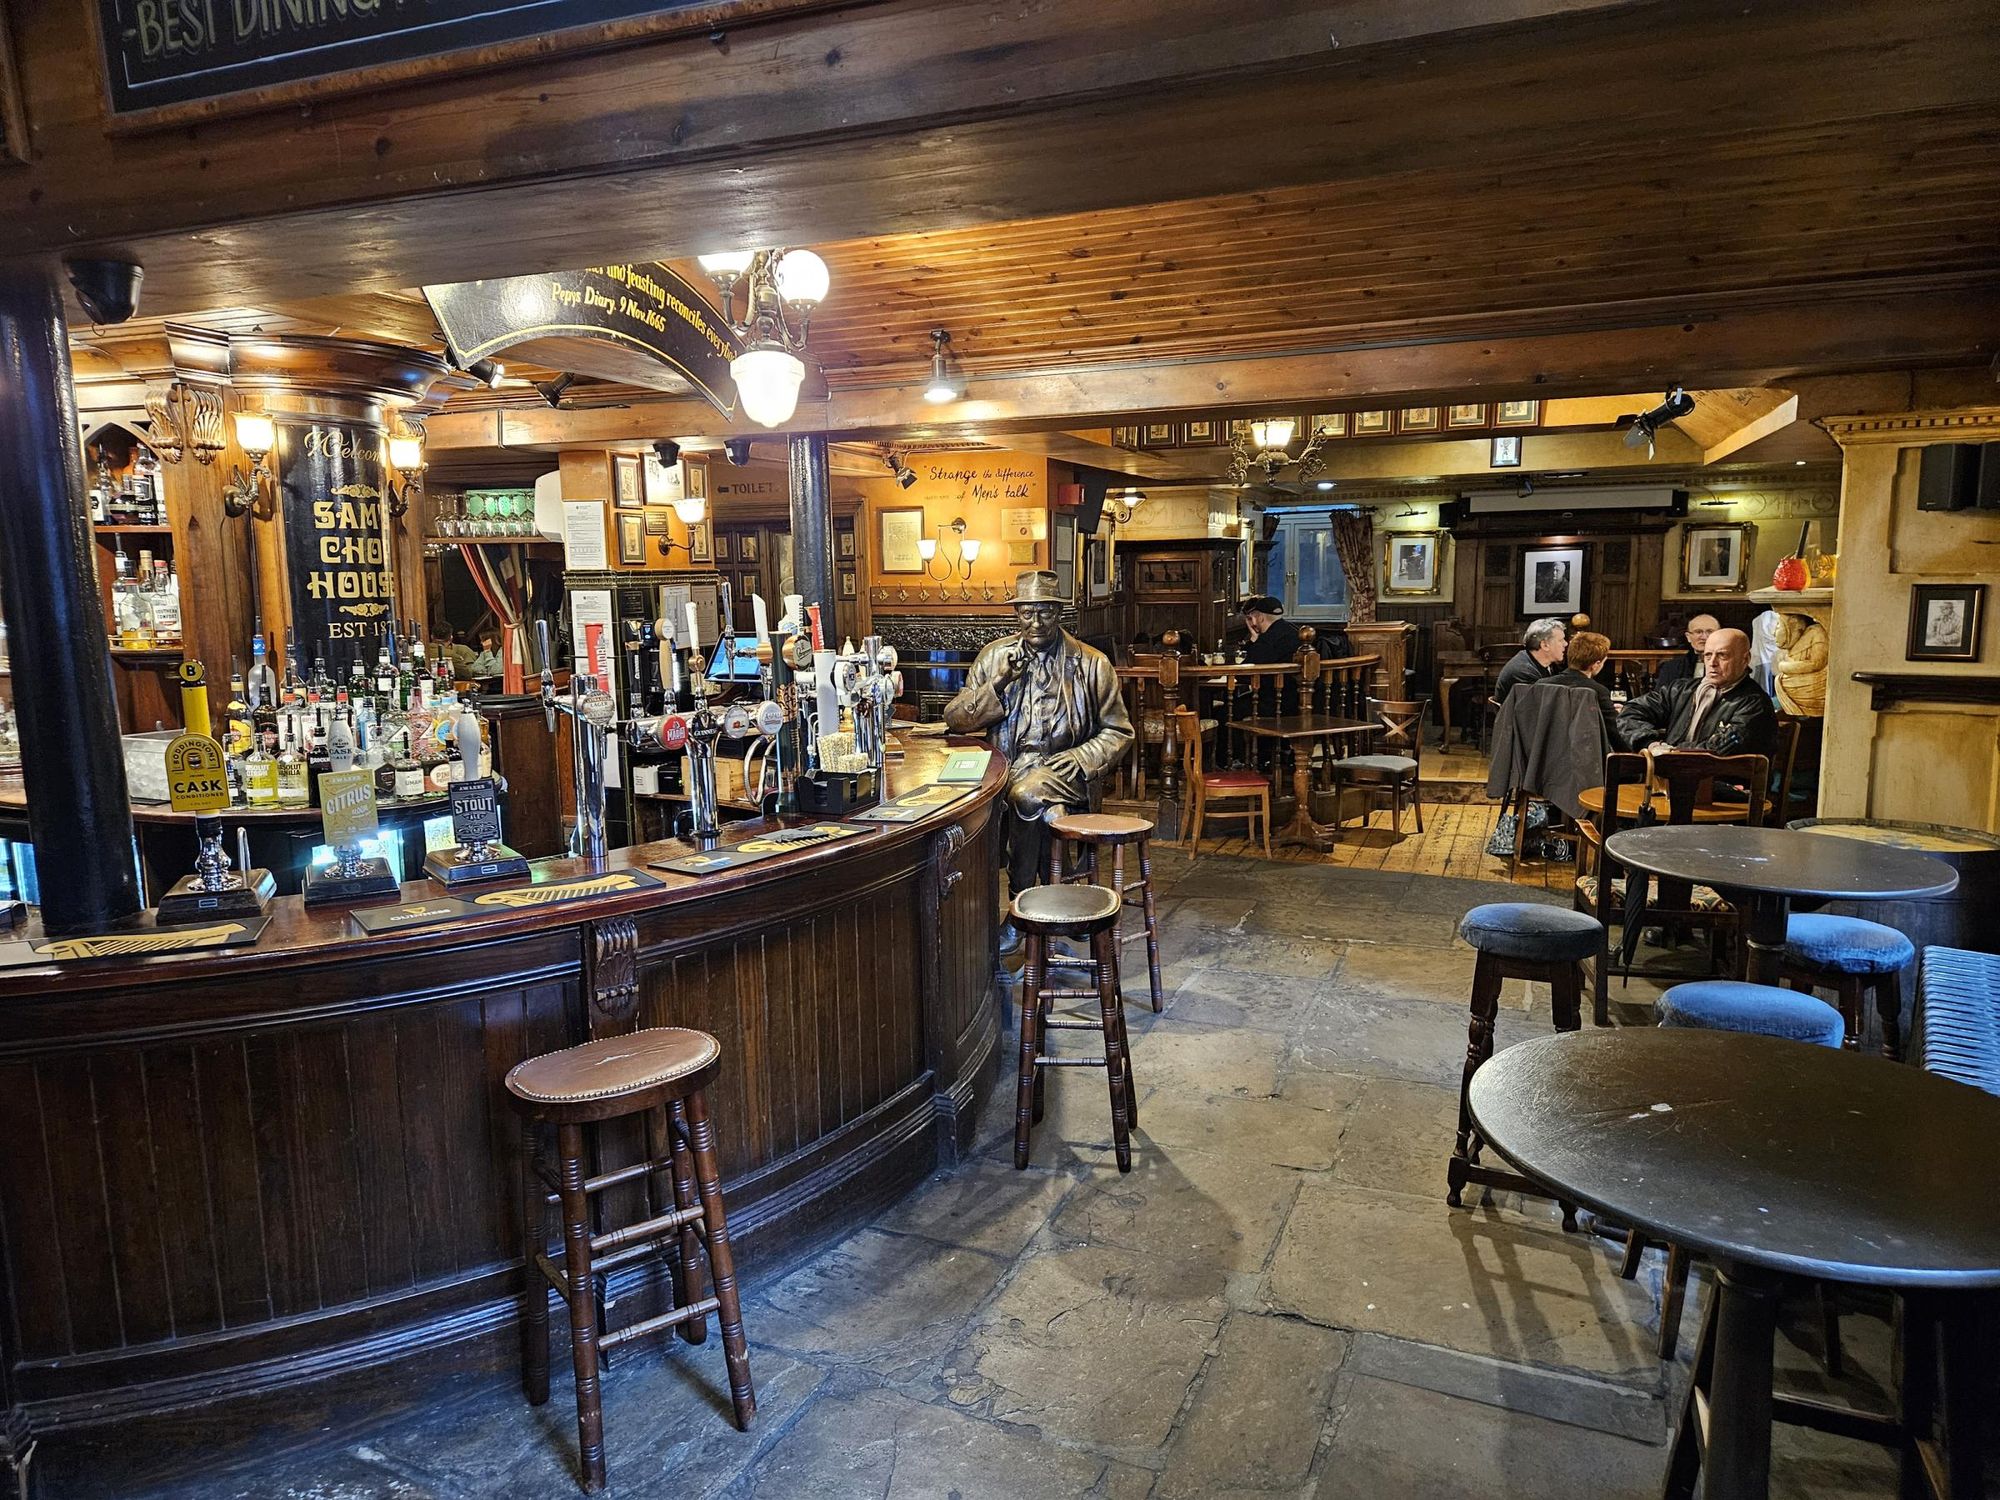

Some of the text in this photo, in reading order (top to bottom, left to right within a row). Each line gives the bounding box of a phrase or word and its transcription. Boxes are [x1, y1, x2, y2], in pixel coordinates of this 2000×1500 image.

[552, 282, 581, 307] Pepys
[626, 263, 666, 310] feasting
[666, 293, 706, 335] reconciles
[995, 467, 1035, 482] difference
[972, 483, 999, 504] Men's
[319, 536, 383, 564] CHO
[328, 622, 367, 639] EST
[186, 664, 196, 677] B
[173, 740, 216, 764] BODDINGTONS
[174, 779, 223, 793] CASK
[175, 792, 225, 800] CONDITIONED
[327, 784, 371, 815] CITRUS
[454, 797, 493, 814] STOUT
